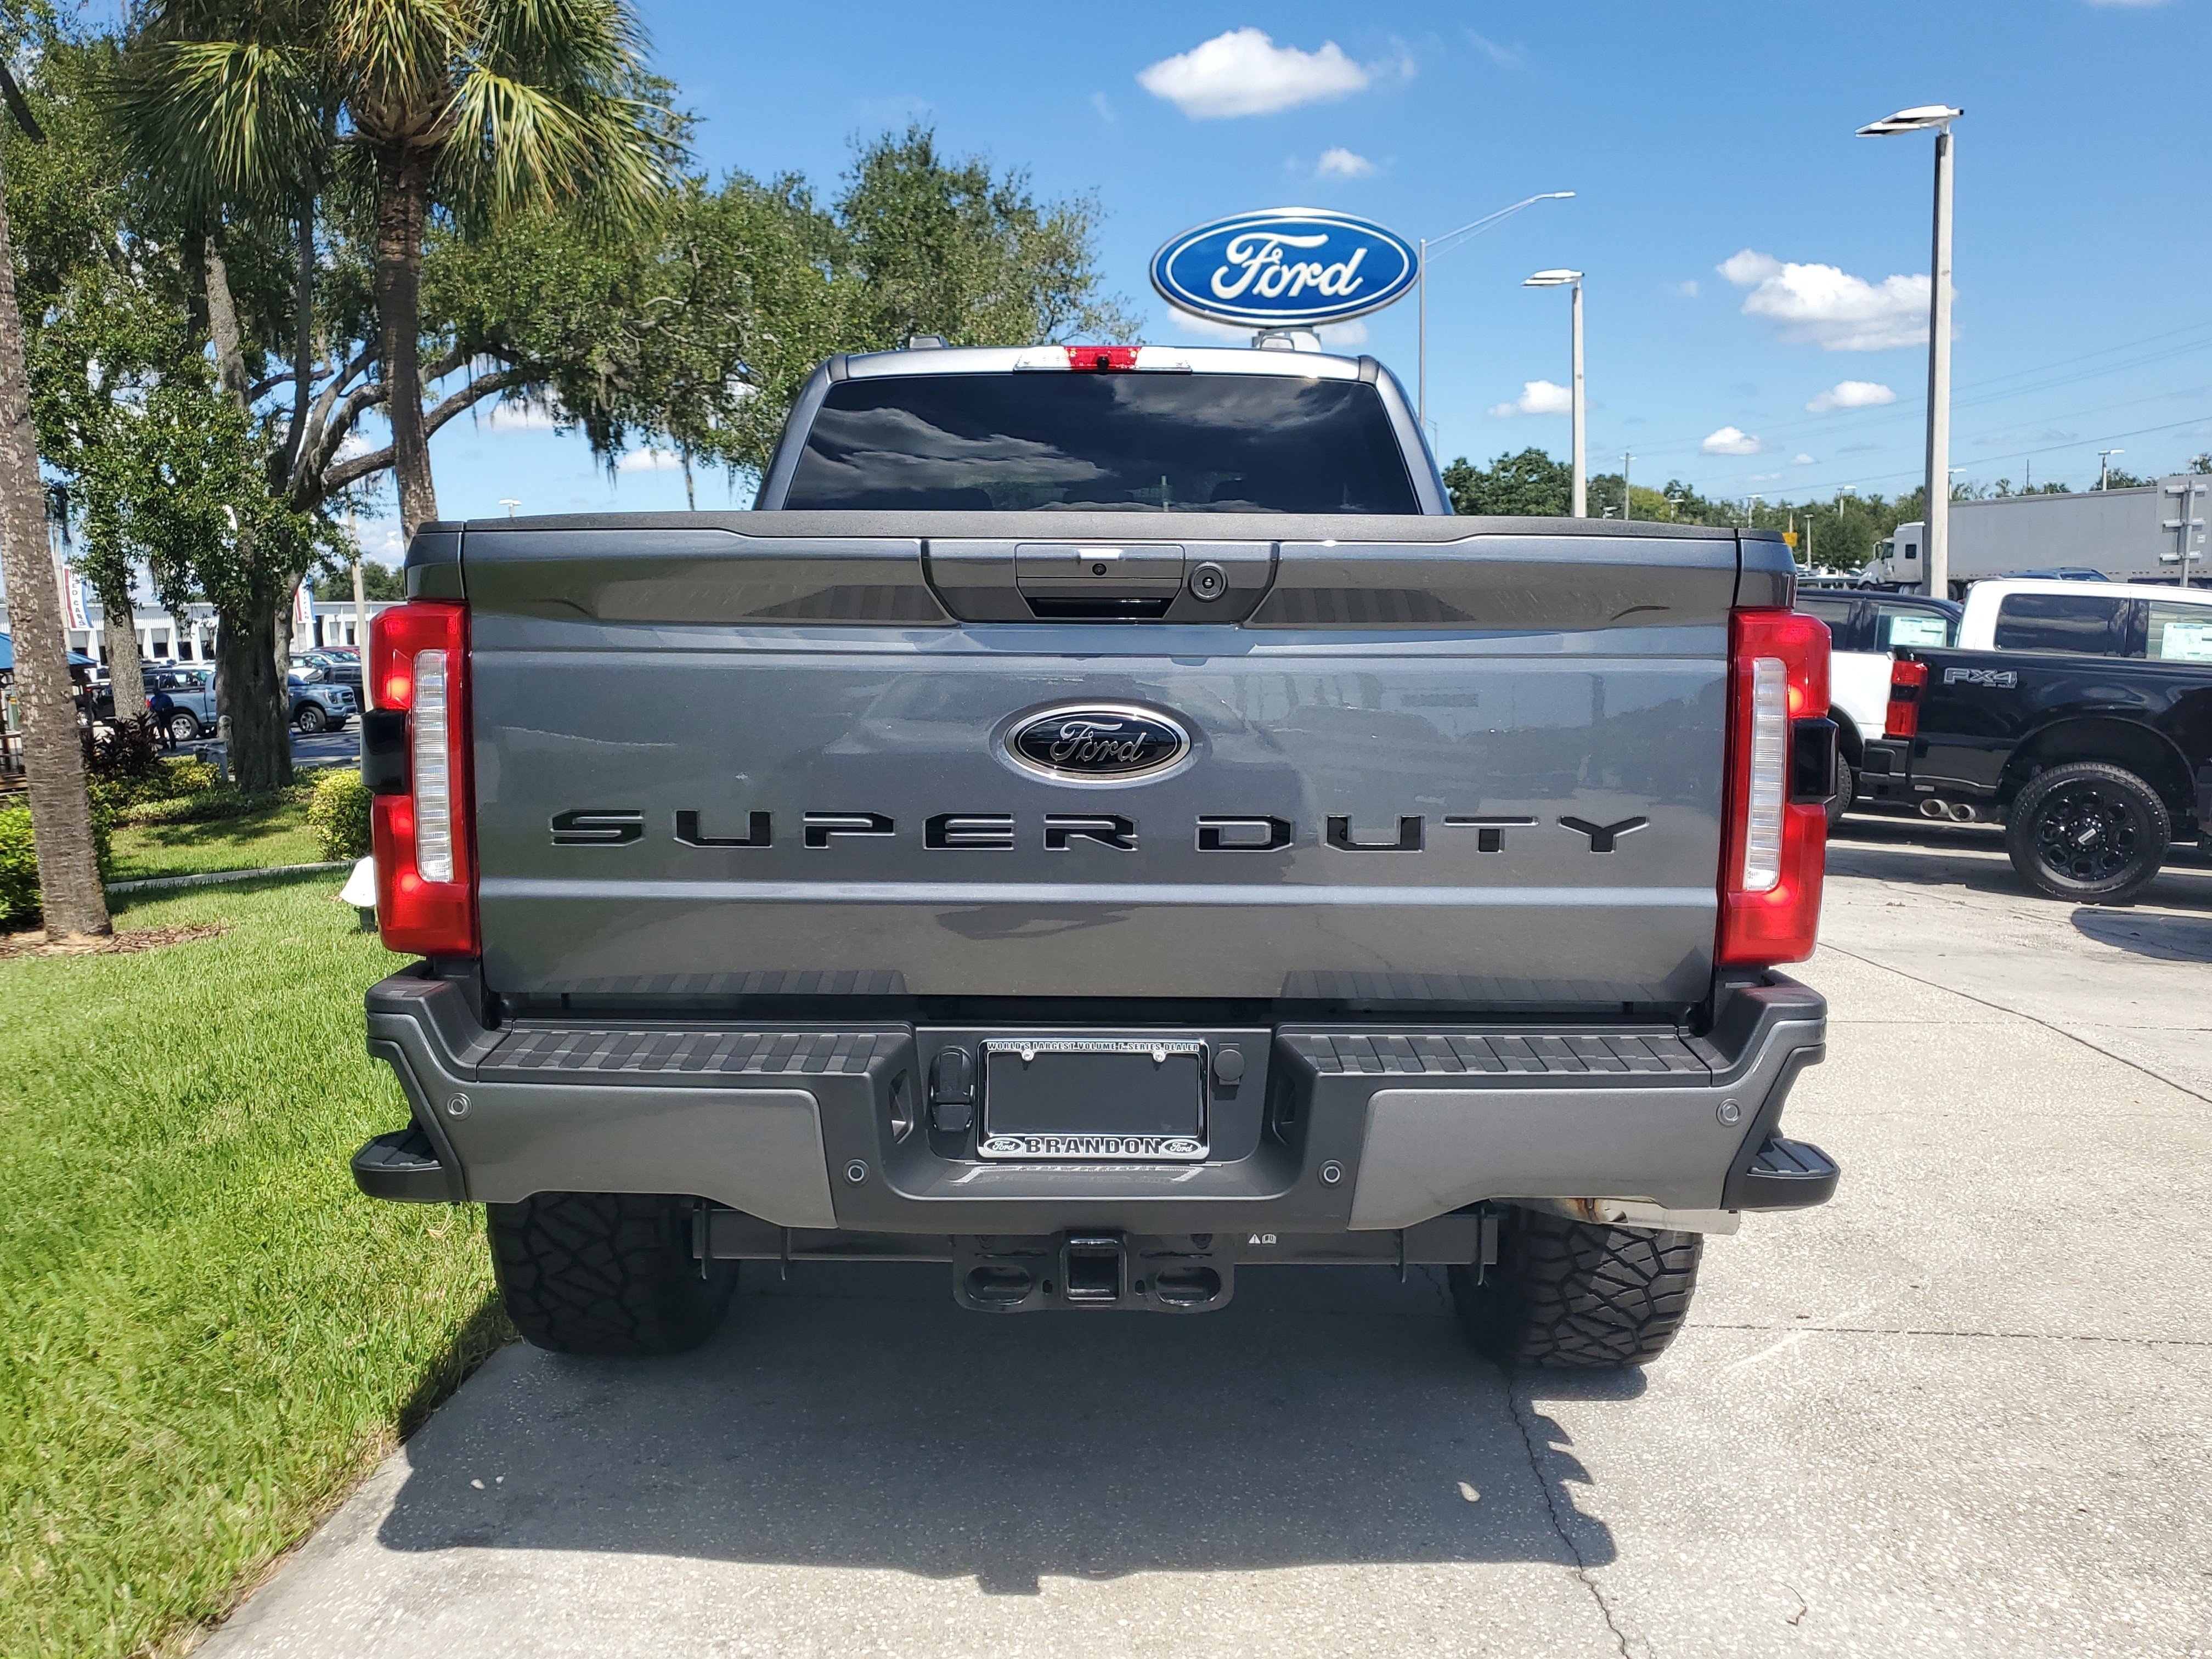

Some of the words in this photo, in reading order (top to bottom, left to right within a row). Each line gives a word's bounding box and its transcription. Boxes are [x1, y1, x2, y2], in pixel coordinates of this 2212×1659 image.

[1211, 232, 1368, 300] Ford
[74, 600, 86, 626] CARS
[1944, 667, 2018, 685] FX4
[1049, 721, 1147, 762] Ford
[550, 809, 1139, 851] SUPER
[1194, 814, 1650, 853] DUTY
[988, 1042, 1030, 1051] WORLD'S
[1033, 1042, 1075, 1050] LARGEST
[1077, 1042, 1116, 1050] VOLUME
[992, 1141, 1015, 1150] Ford
[1024, 1137, 1161, 1155] BRANDON
[1169, 1142, 1193, 1152] Ford
